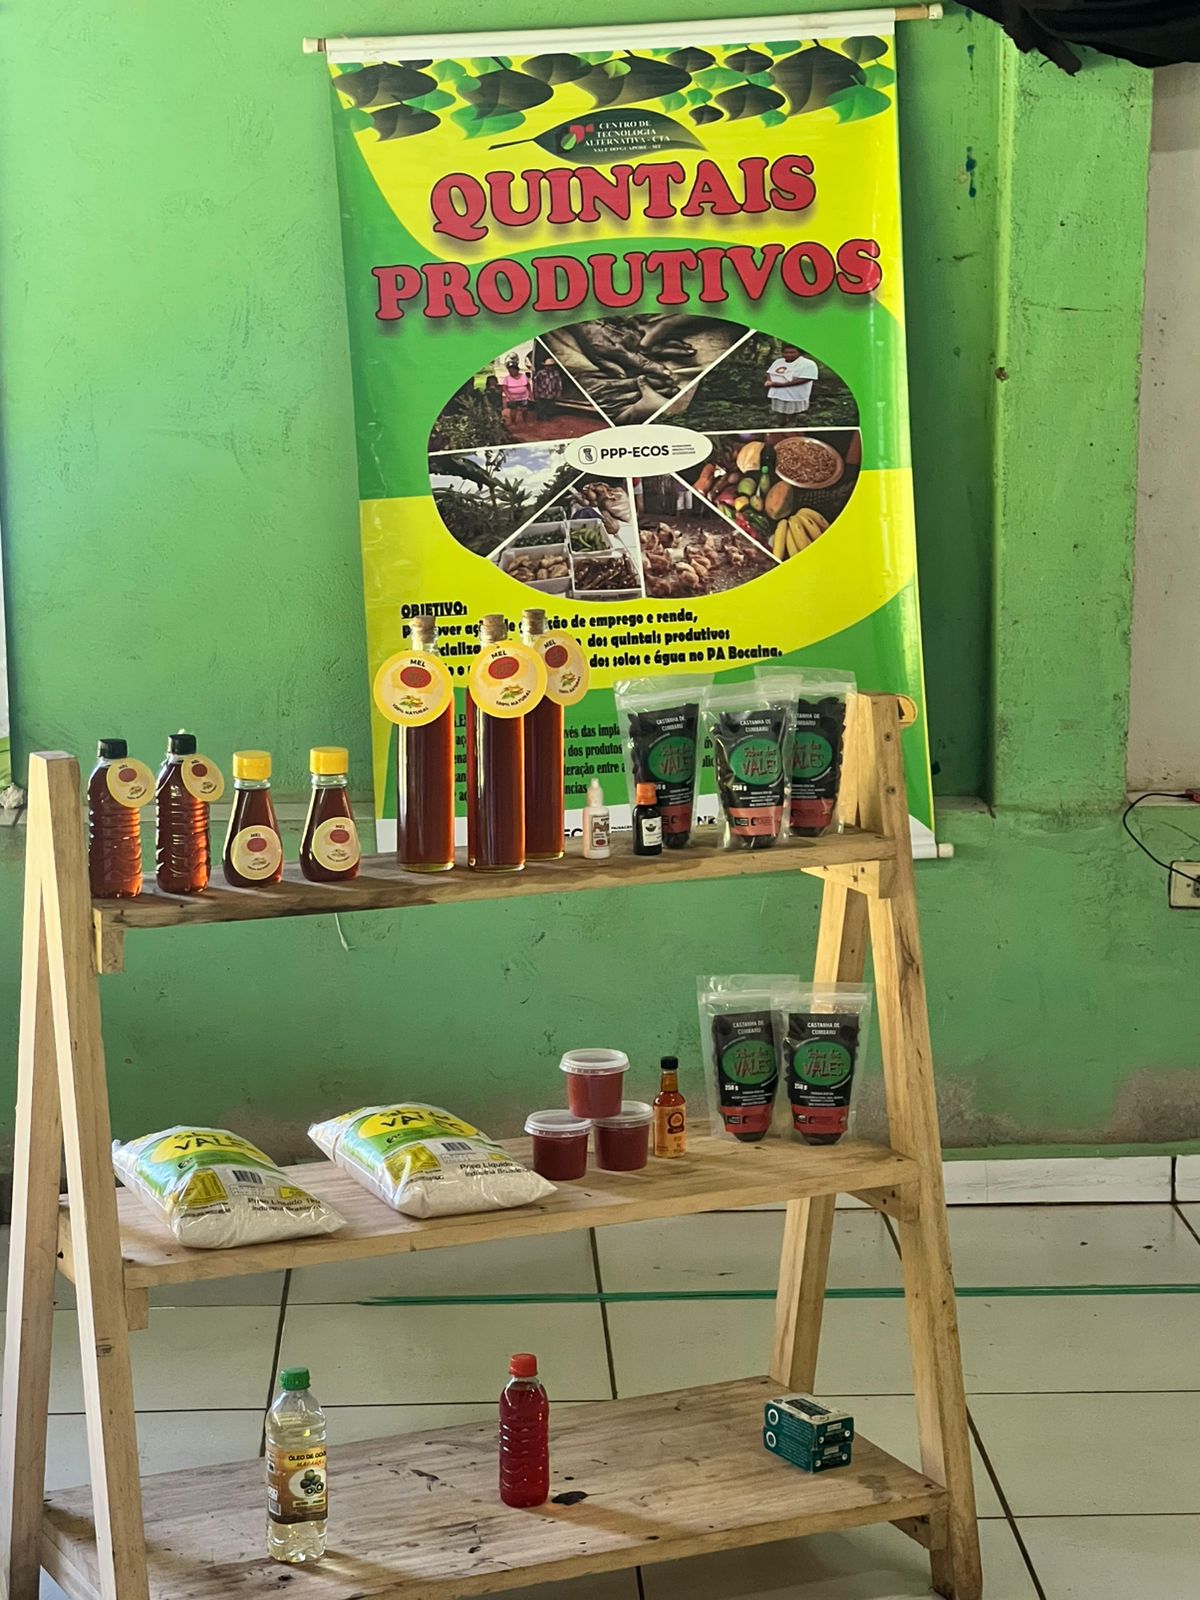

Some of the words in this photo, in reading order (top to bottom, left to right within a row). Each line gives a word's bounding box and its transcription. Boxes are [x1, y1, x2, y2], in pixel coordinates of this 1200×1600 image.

[599, 120, 637, 130] CENTRO
[597, 128, 656, 138] TECNOLOGIA
[584, 136, 646, 147] ALTERNATIVA
[652, 135, 671, 143] CTA
[430, 154, 817, 242] QUINTAIS
[371, 238, 883, 320] PRODUTIVOS
[601, 445, 669, 459] PPP-ECOS
[571, 614, 586, 628] de
[589, 613, 643, 629] emprego
[646, 613, 654, 624] e
[657, 608, 698, 624] renda,
[587, 633, 608, 648] dos
[610, 631, 661, 648] quintais
[664, 627, 730, 645] produtivos
[543, 640, 556, 649] MEL
[491, 650, 508, 659] MEL
[589, 654, 609, 668] dos
[613, 652, 641, 668] solos
[644, 655, 651, 665] e
[654, 650, 686, 667] água
[689, 651, 704, 662] no
[707, 647, 725, 661] PA
[728, 645, 782, 660] Bocaina.
[410, 659, 426, 668] MEL
[581, 725, 596, 738] das
[568, 745, 583, 757] dos
[585, 742, 623, 759] produtos
[597, 761, 619, 774] entre
